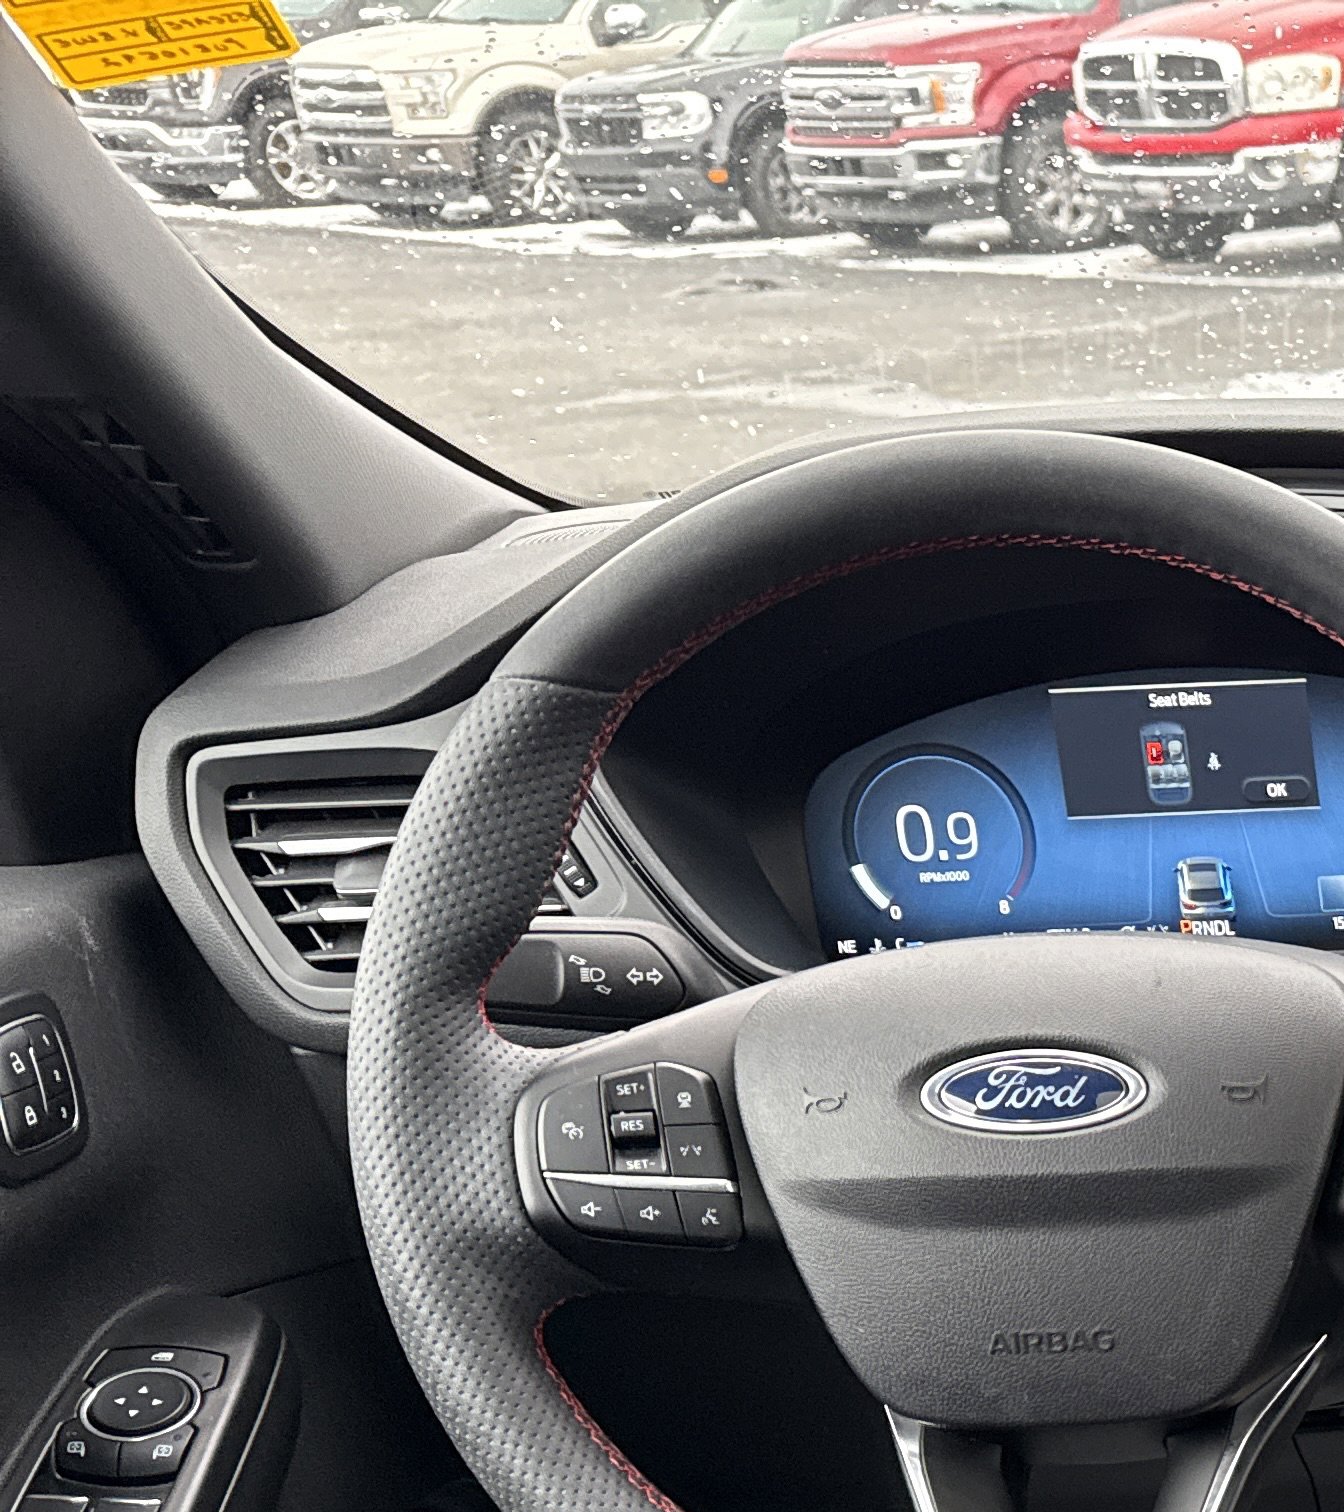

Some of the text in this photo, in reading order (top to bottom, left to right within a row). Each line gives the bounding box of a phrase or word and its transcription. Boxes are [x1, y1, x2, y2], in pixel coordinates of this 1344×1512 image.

[1148, 691, 1212, 707] Seat Belts
[1266, 783, 1288, 797] OK
[895, 804, 979, 862] 0.9
[890, 905, 902, 919] 0
[837, 939, 857, 954] NE
[974, 1065, 1088, 1110] Ford
[620, 1119, 645, 1132] RES
[988, 1329, 1117, 1356] AIRBAG
